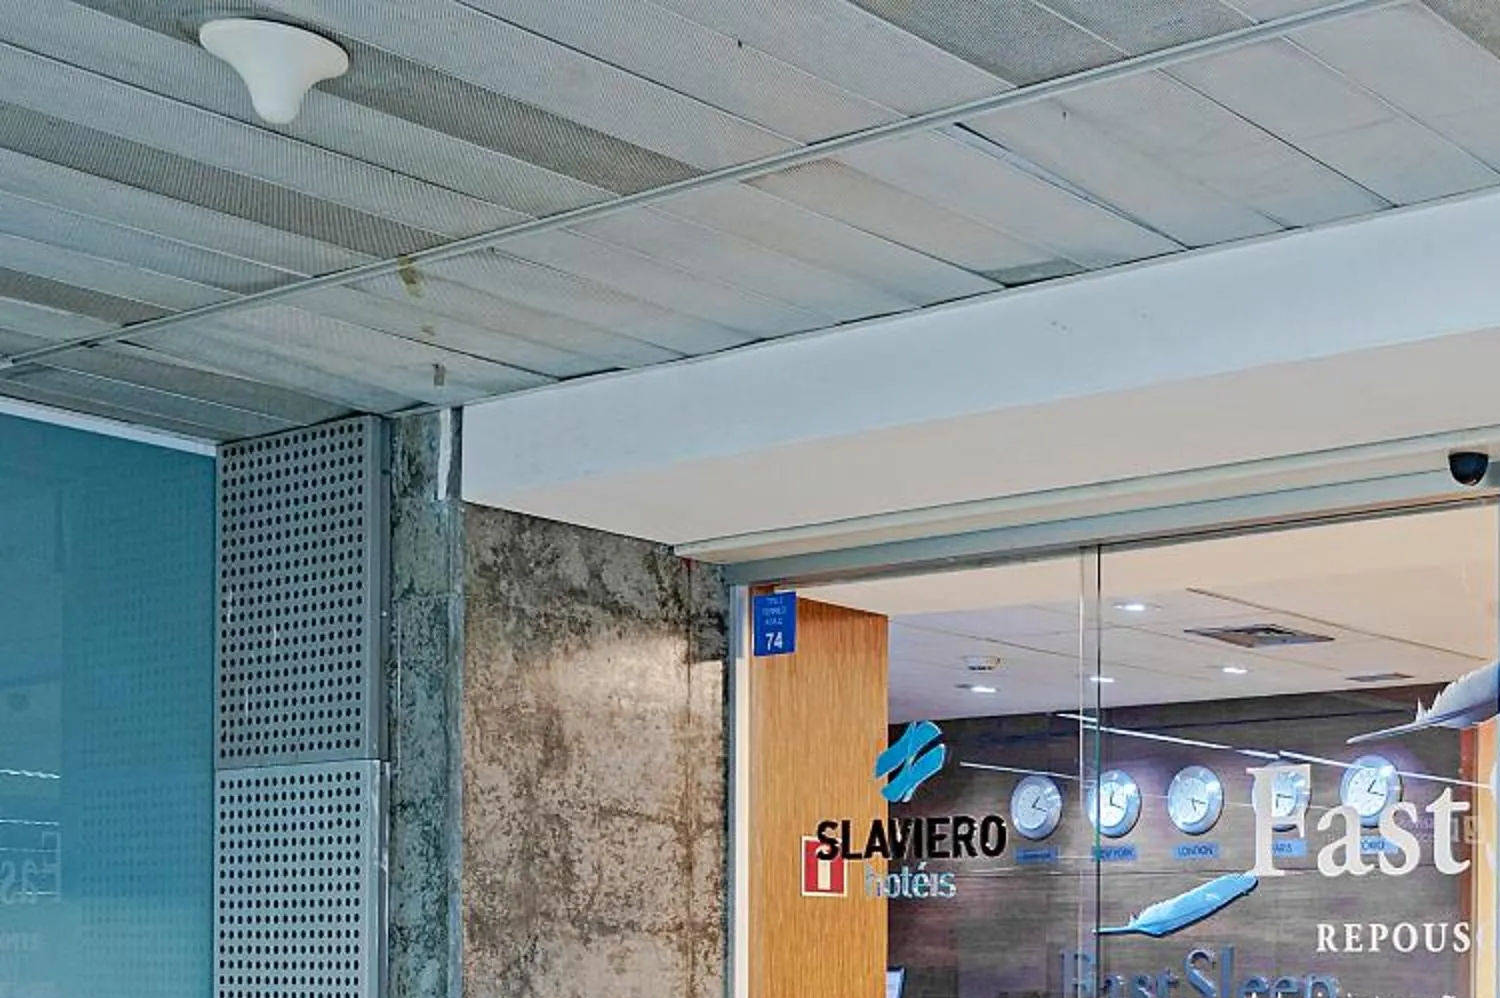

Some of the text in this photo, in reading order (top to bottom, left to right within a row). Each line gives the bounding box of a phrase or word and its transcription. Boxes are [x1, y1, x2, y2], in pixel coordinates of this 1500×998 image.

[765, 631, 783, 651] 74
[815, 814, 1007, 862] SLAVIERO
[865, 863, 957, 898] hotéis
[1316, 921, 1497, 954] REPOUSO
